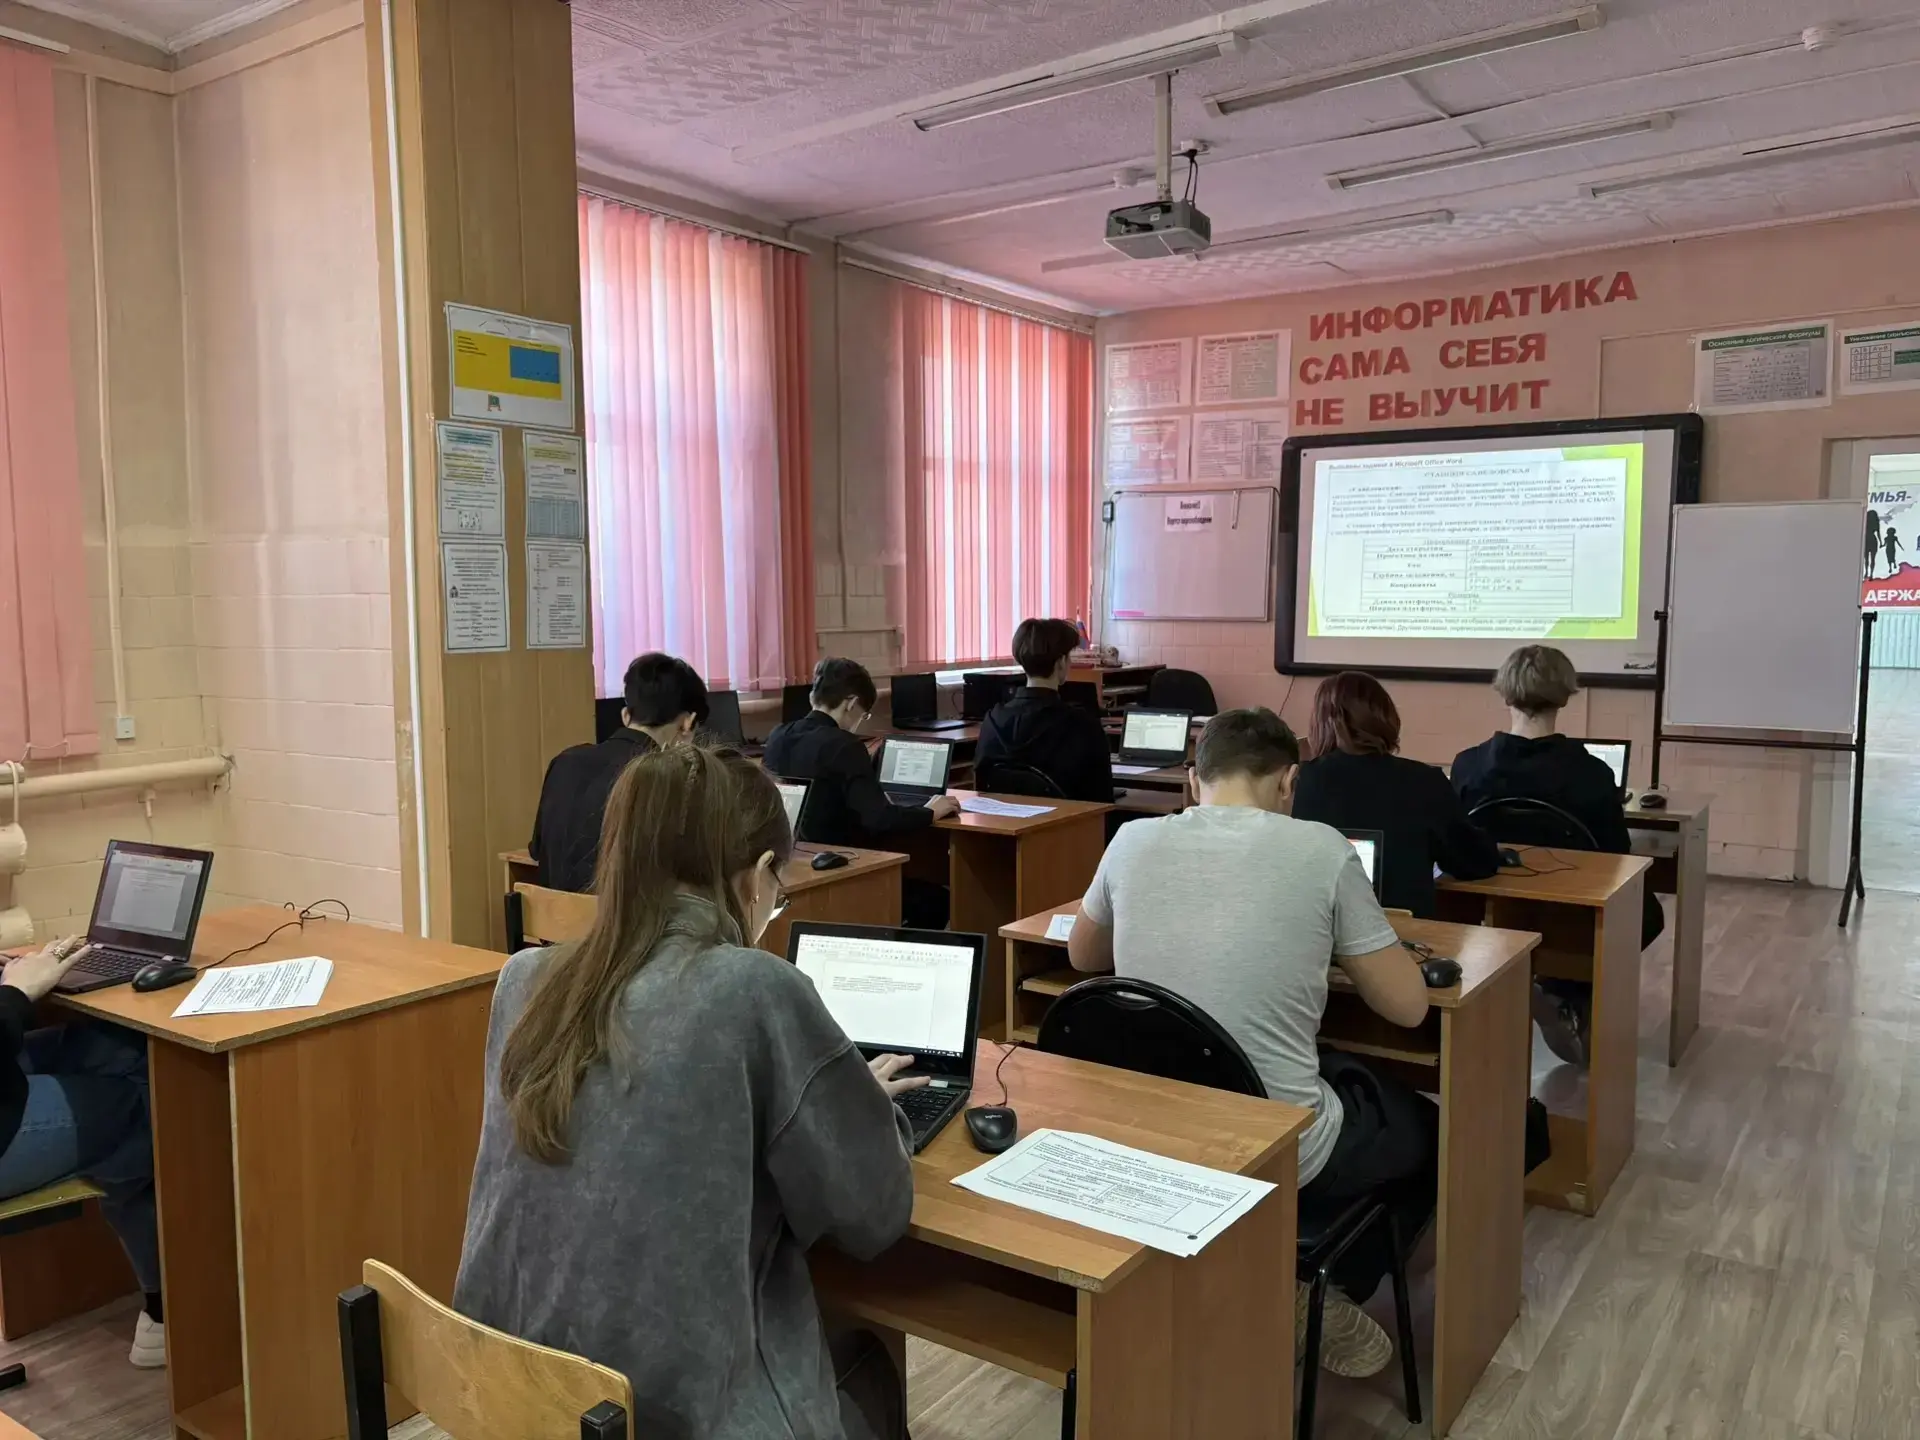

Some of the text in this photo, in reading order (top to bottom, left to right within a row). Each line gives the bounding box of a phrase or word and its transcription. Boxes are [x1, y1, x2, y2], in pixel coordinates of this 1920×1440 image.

[1309, 271, 1638, 342] ИНФОРМАТИКА
[1708, 338, 1744, 348] Основные
[1299, 346, 1411, 385] САМА
[1438, 332, 1546, 369] СЕБЯ
[1295, 378, 1550, 426] НЕ ВЫУЧИТ
[1395, 459, 1423, 468] Microsoft
[1424, 458, 1444, 466] Office
[1445, 457, 1463, 465] Word
[1868, 491, 1912, 504] МЬЯ-
[1865, 589, 1920, 604] ДЕРЖА
